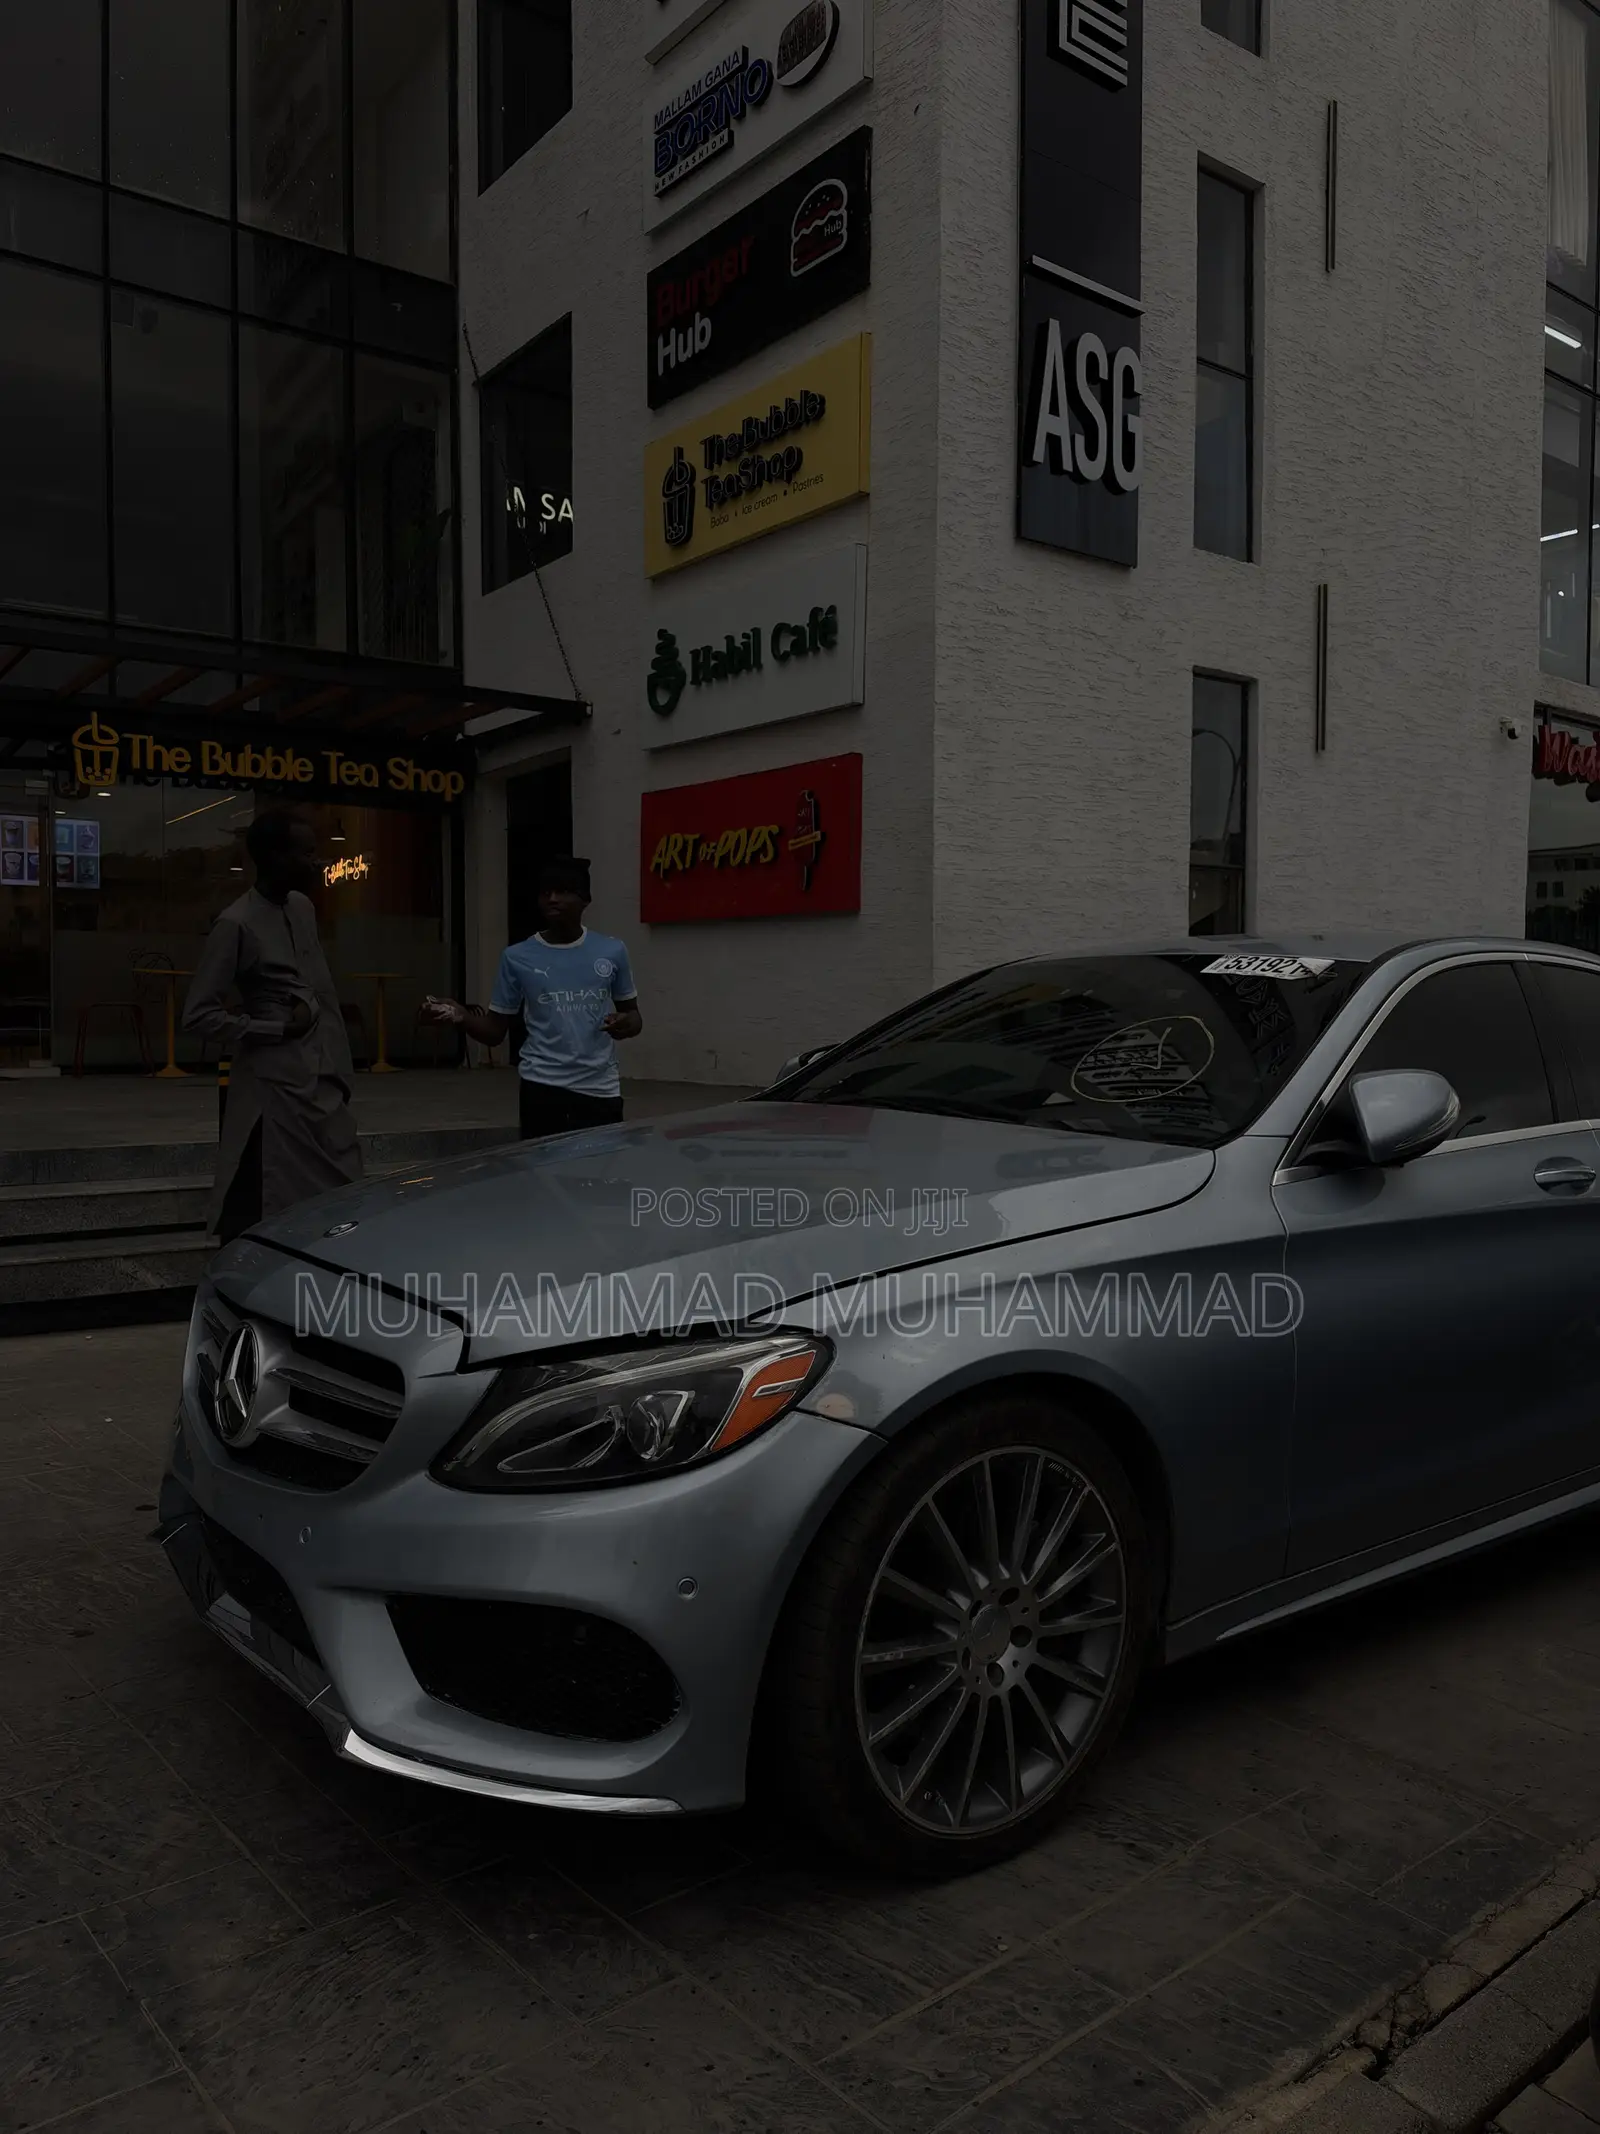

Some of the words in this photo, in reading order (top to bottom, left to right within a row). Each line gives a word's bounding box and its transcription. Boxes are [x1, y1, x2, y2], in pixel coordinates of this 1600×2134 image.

[654, 80, 702, 130] MALLAM
[704, 51, 740, 87] GANA
[655, 58, 769, 177] BORNO
[655, 172, 676, 192] NEW
[678, 136, 725, 174] FASHION
[823, 219, 843, 237] Hub
[656, 235, 758, 329] Burger
[657, 311, 713, 377] Hub
[701, 433, 742, 471] The
[742, 389, 826, 452] Bubble
[1032, 317, 1142, 492] ASG
[701, 474, 739, 511] Tea
[738, 445, 804, 488] Shop
[710, 512, 729, 529] Boba
[754, 494, 779, 511] cream
[690, 627, 763, 686] Habil
[771, 605, 838, 662] Café
[121, 731, 192, 774] The
[201, 740, 315, 784] Bubble
[321, 750, 380, 789] Tea
[387, 756, 465, 802] Shop
[650, 832, 701, 879] ART
[714, 824, 780, 870] POPS
[538, 988, 608, 1004] ETIHAD
